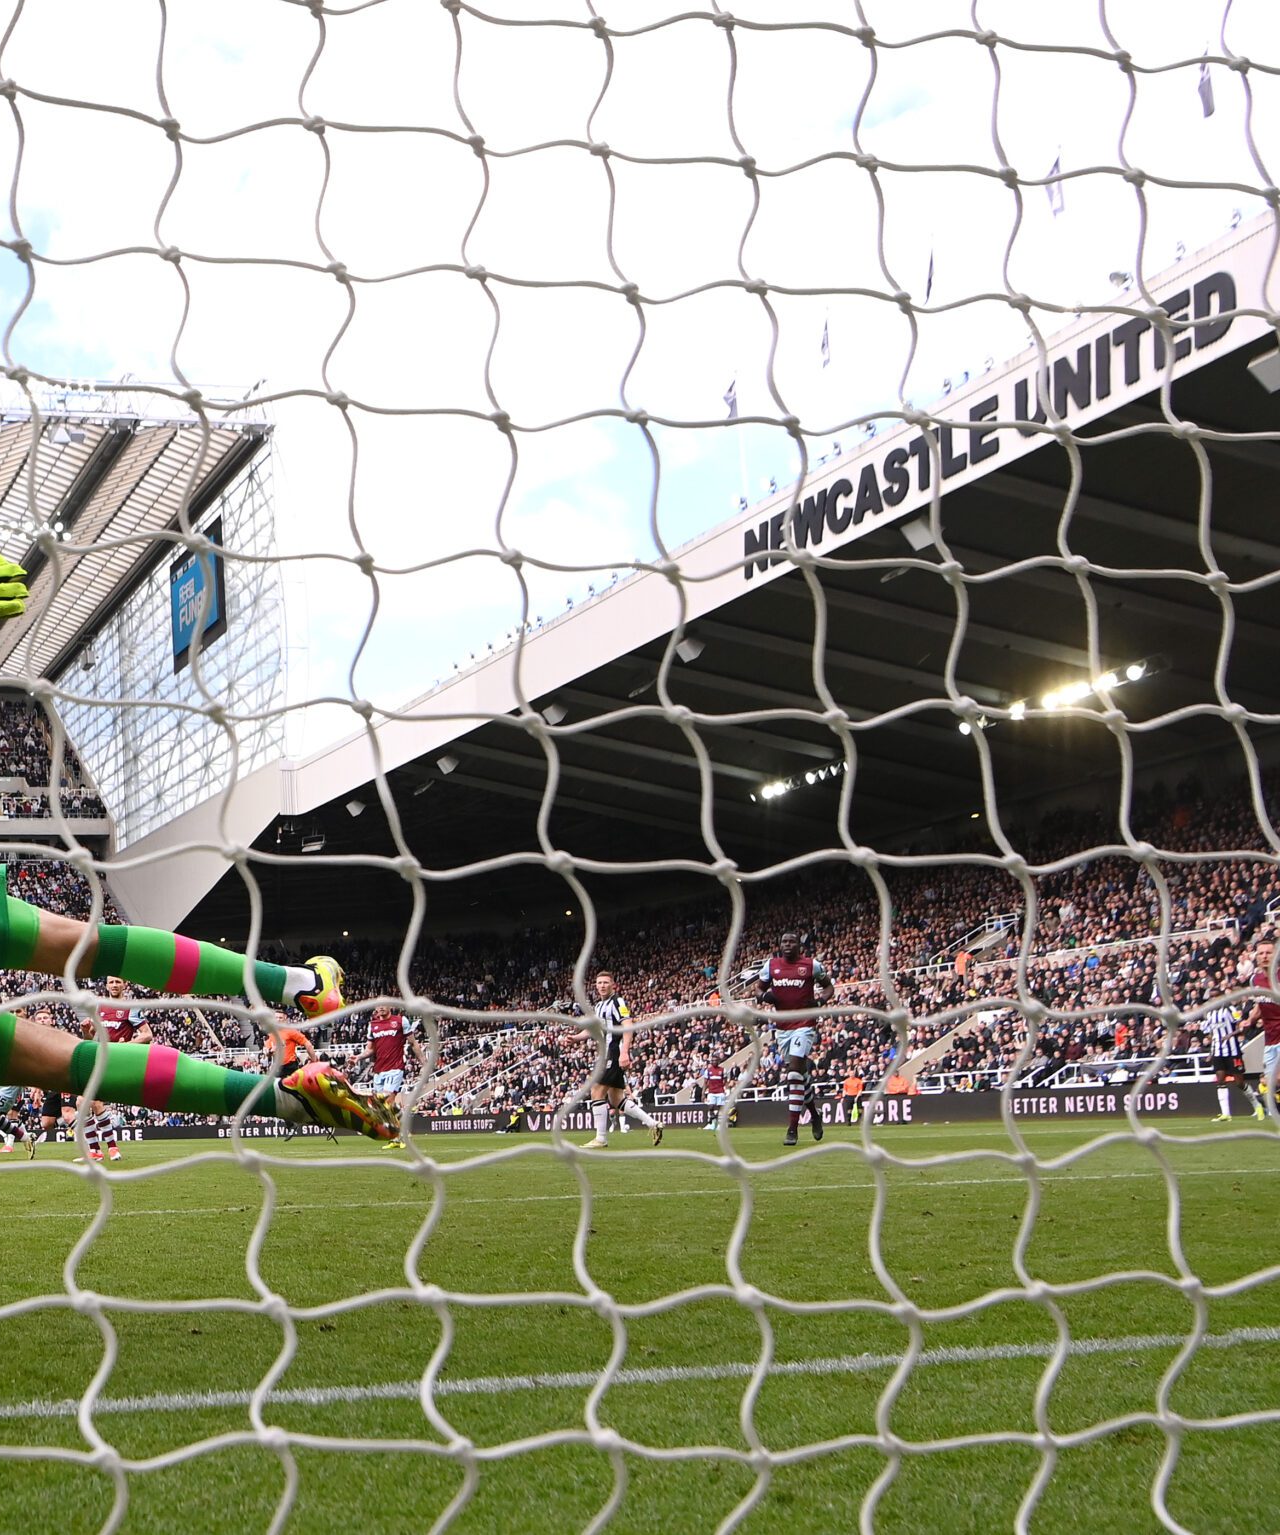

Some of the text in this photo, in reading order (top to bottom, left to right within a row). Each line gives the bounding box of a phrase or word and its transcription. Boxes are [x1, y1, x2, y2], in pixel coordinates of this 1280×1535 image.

[744, 271, 1238, 580] NEWCASTLE UNITED
[772, 978, 805, 988] betway
[372, 1029, 398, 1039] betway
[793, 1036, 801, 1048] 4
[1064, 1094, 1117, 1113] NEVER
[1123, 1092, 1179, 1111] STOPS
[647, 1111, 673, 1125] ETTER
[675, 1110, 704, 1124] NEVER
[822, 1098, 913, 1124] CATORE
[431, 1118, 494, 1131] BETTER NEVER STOPS
[544, 1111, 598, 1131] CSTOR
[55, 1129, 144, 1143] CTRE
[218, 1127, 260, 1138] BETER
[264, 1125, 298, 1136] NEV
